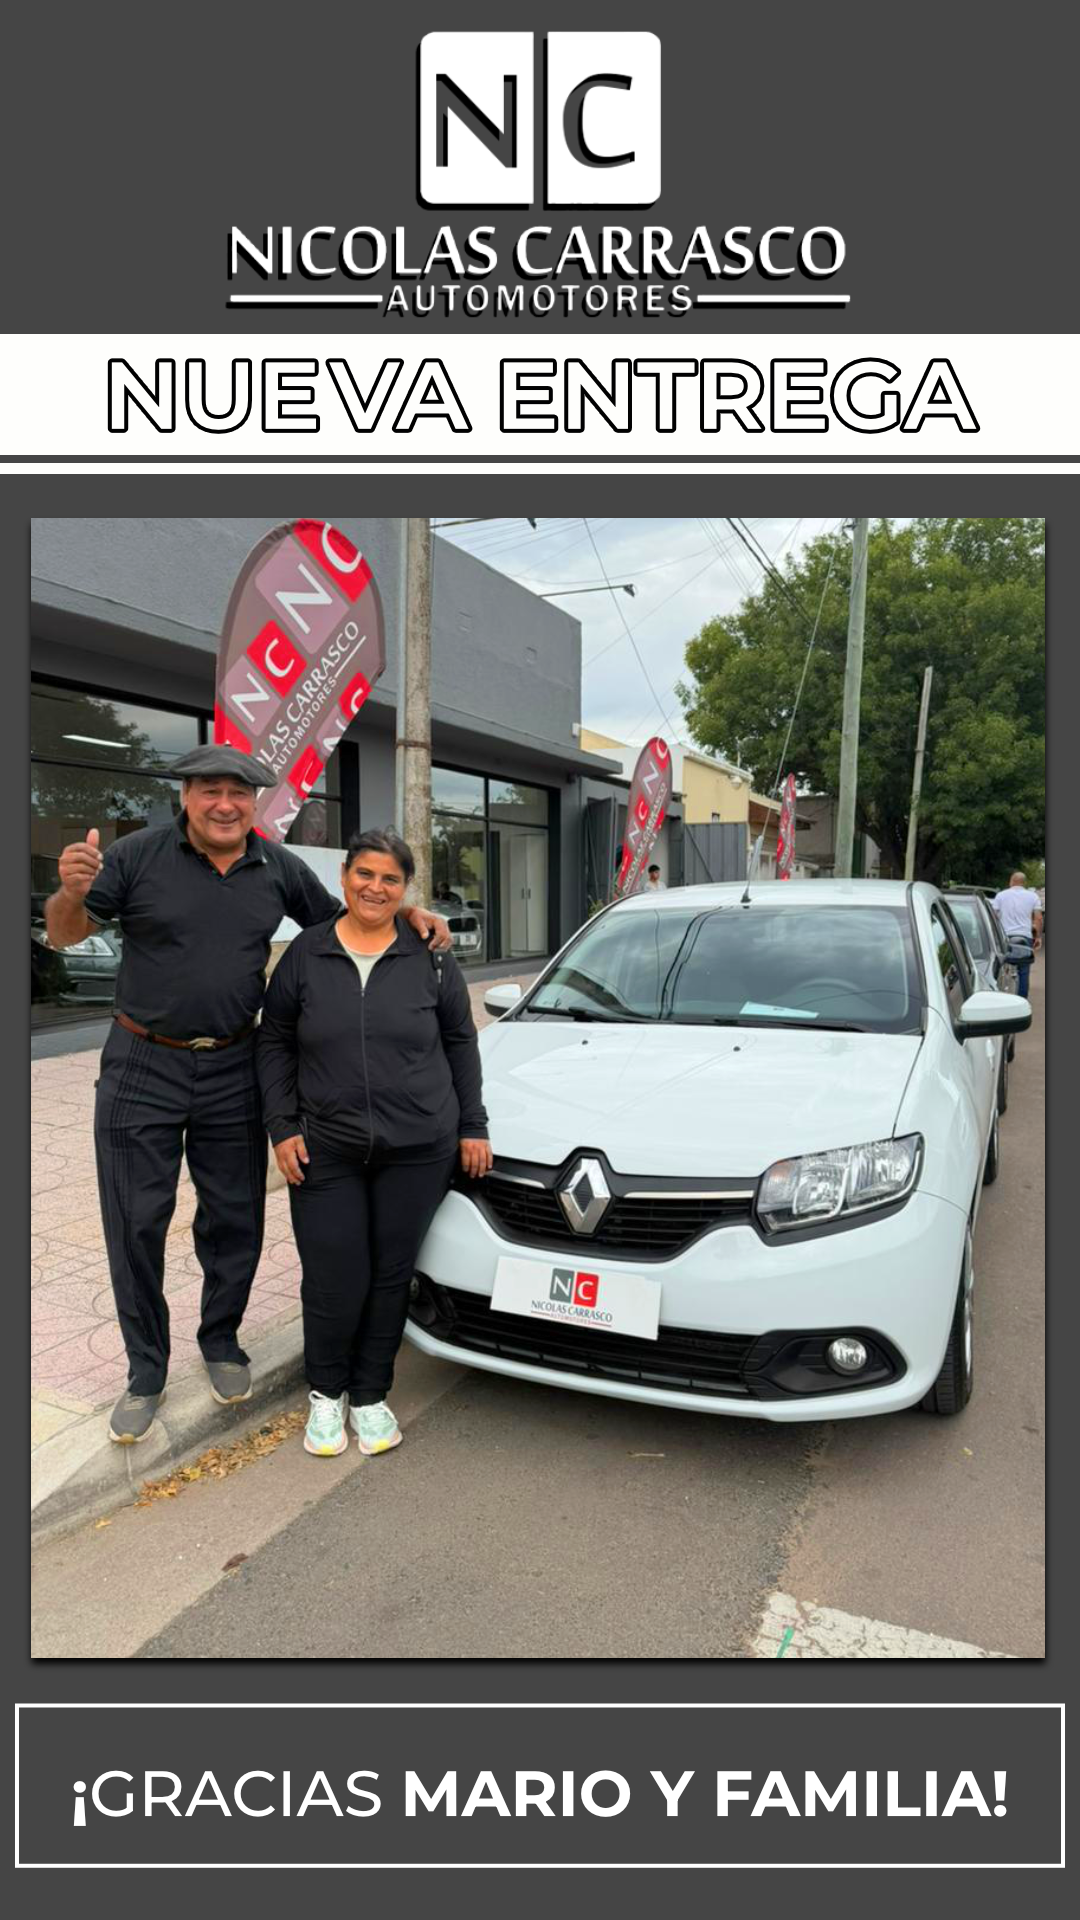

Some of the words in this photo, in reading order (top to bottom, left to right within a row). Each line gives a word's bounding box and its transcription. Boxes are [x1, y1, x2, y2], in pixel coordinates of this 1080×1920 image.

[286, 621, 359, 723] CARRASCO
[272, 677, 337, 775] AUTOMOTORES
[531, 1300, 567, 1314] NICOLAS
[568, 1306, 613, 1323] CARRASCO
[552, 1275, 594, 1301] NC
